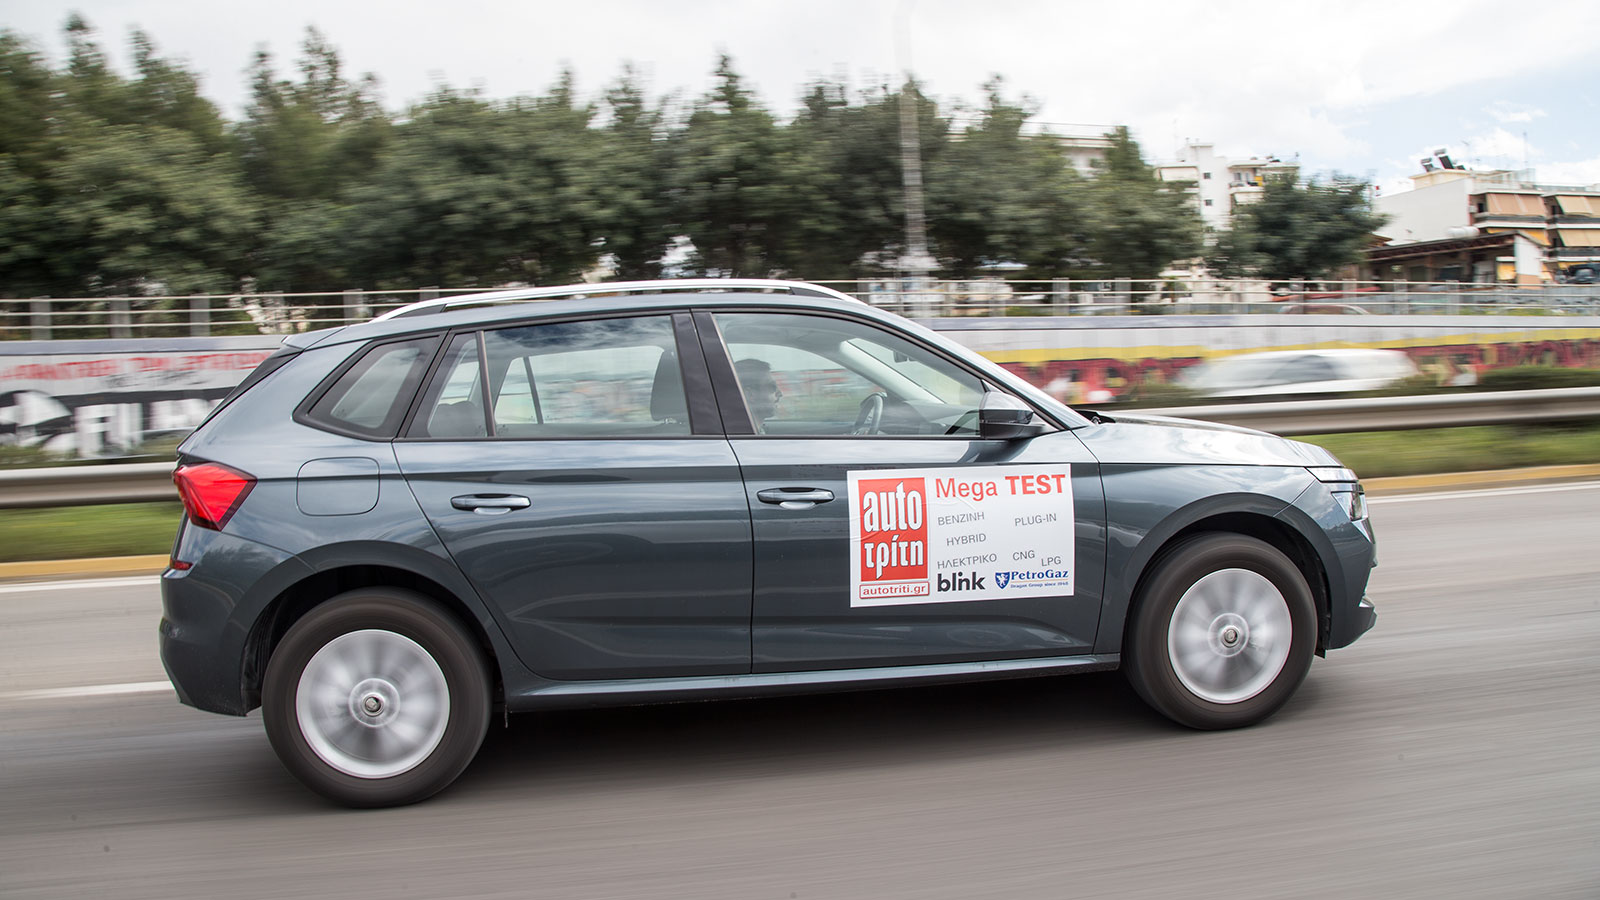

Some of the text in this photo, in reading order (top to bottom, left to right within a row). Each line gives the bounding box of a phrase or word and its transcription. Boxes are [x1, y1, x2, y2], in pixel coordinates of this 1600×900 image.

[936, 474, 1066, 502] Mega TEST
[863, 481, 923, 533] auto
[938, 511, 985, 526] ΒΕΝΖΙΝΗ
[1014, 513, 1057, 527] PLUG-IN
[946, 533, 987, 546] HYBRID
[864, 534, 924, 580] τρίτη
[937, 553, 998, 570] ΗΛΕΚΤΡΙΚΟ
[1012, 550, 1036, 561] CNG
[1041, 556, 1062, 567] LPG
[937, 571, 986, 592] blink
[1011, 569, 1069, 580] PetroGaz
[862, 585, 926, 597] autotriti.gr
